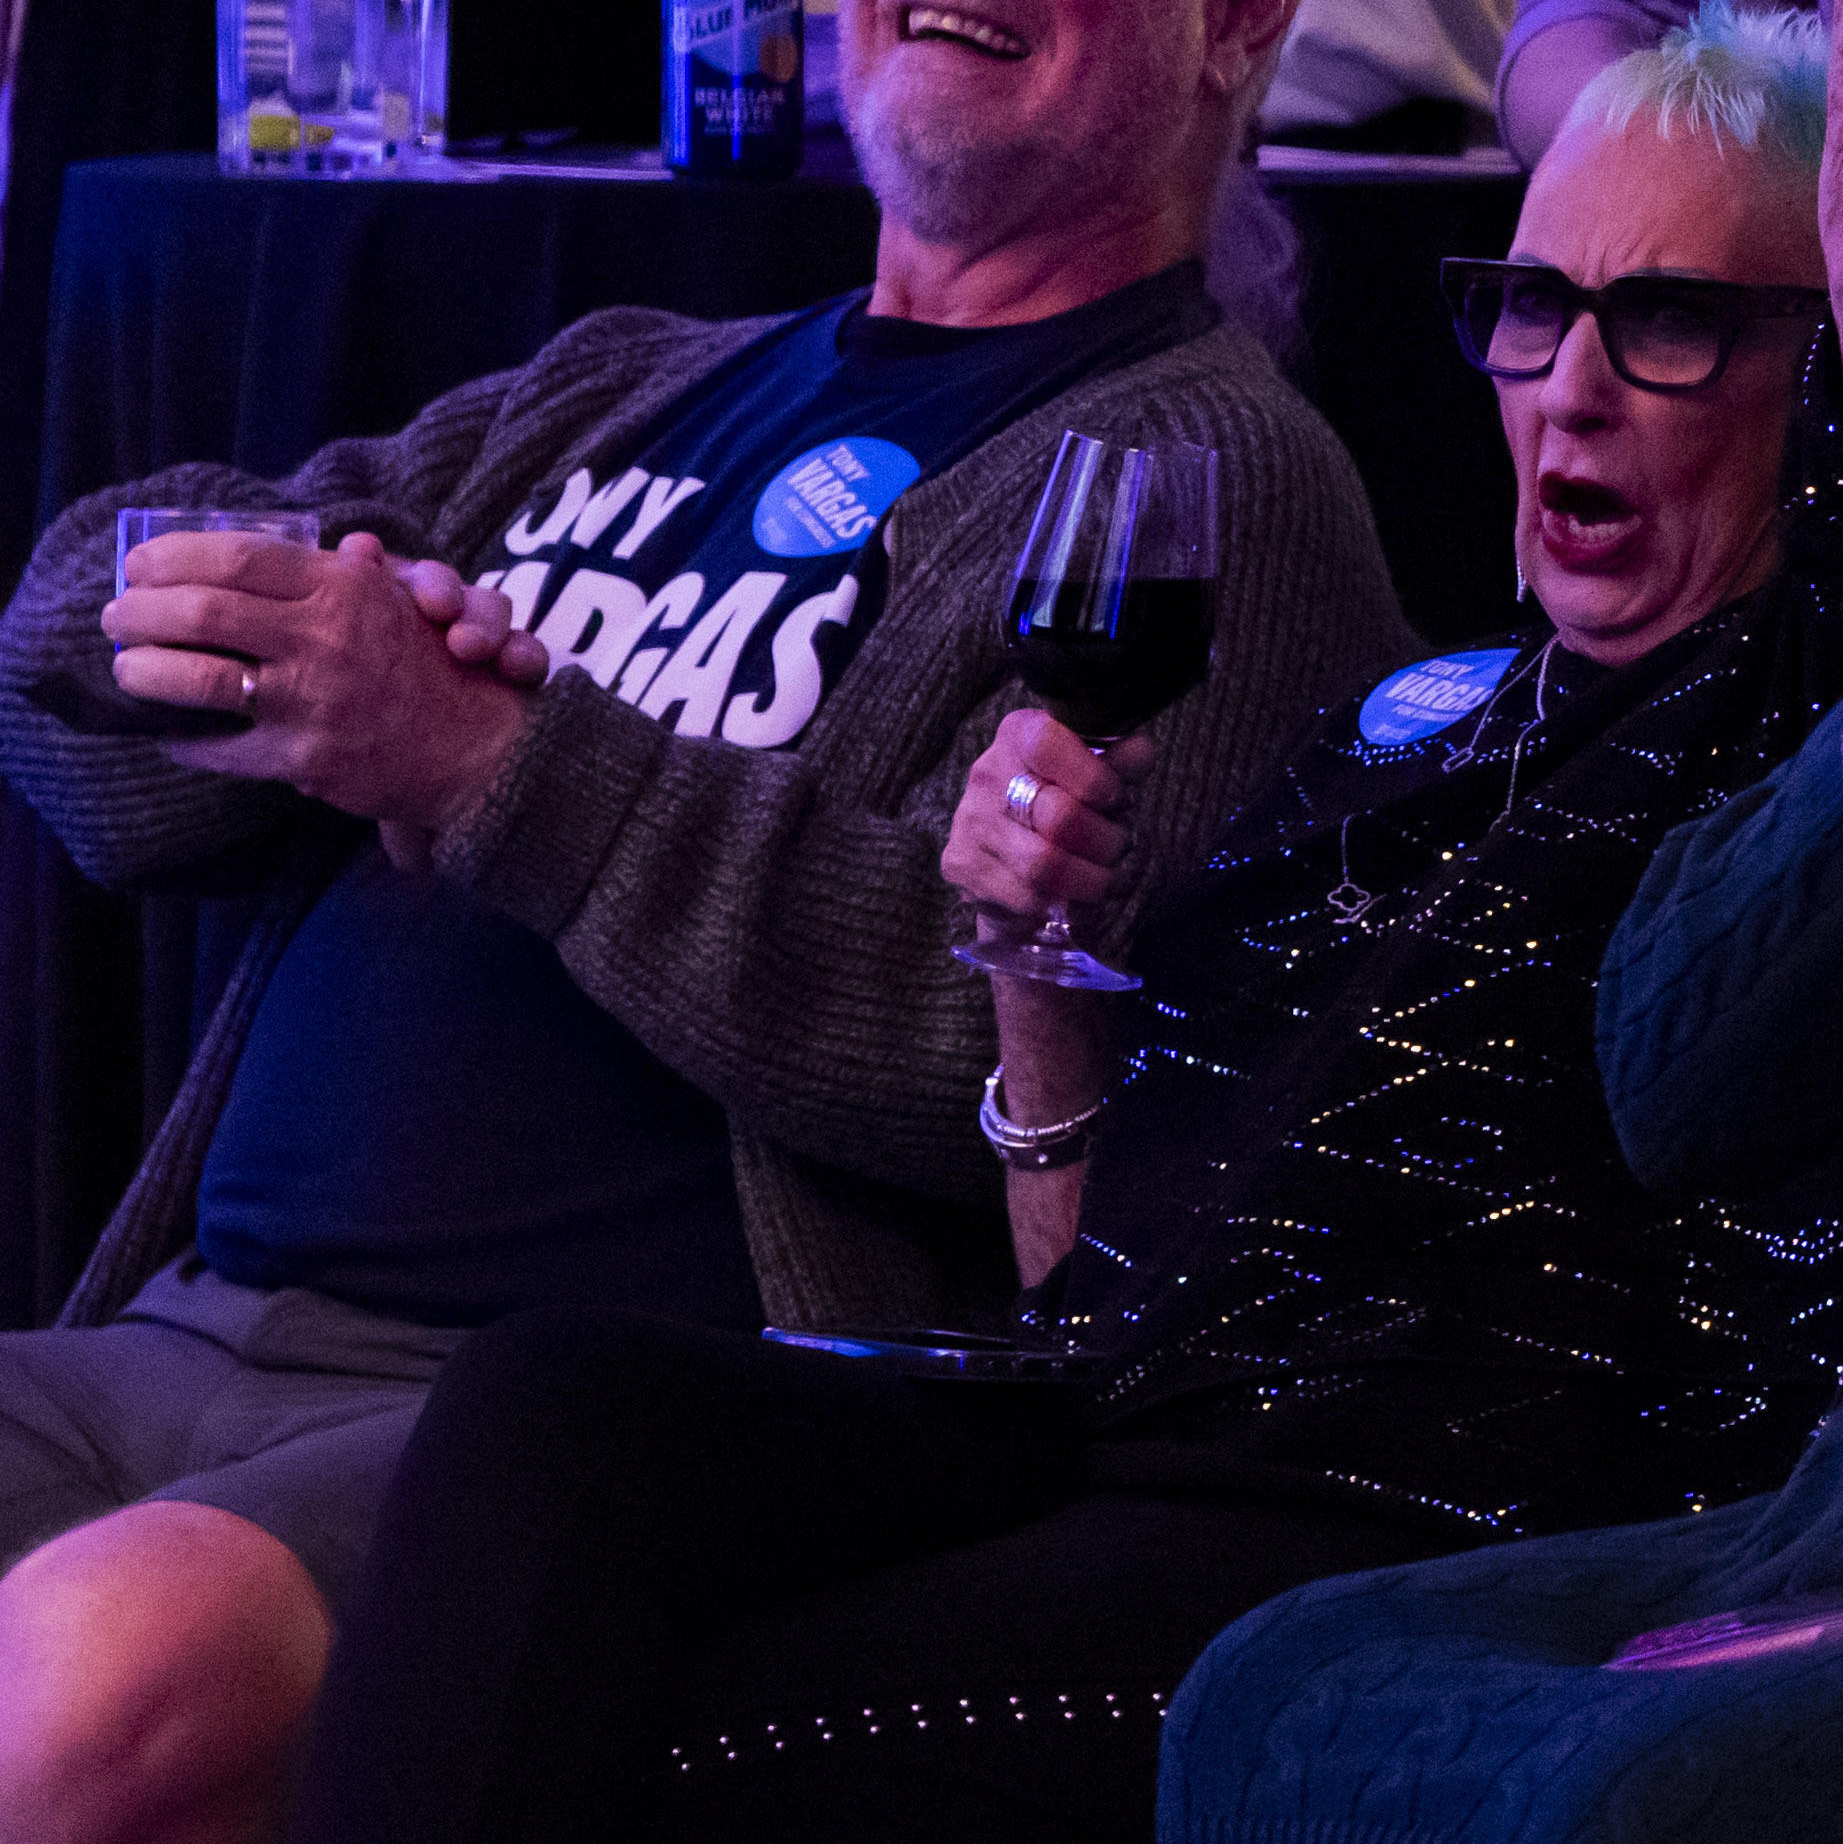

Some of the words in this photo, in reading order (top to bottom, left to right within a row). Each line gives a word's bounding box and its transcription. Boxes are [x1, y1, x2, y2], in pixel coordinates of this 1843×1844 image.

[787, 457, 878, 539] VARGAS
[476, 561, 860, 749] ARGAS
[1419, 659, 1477, 680] TONY
